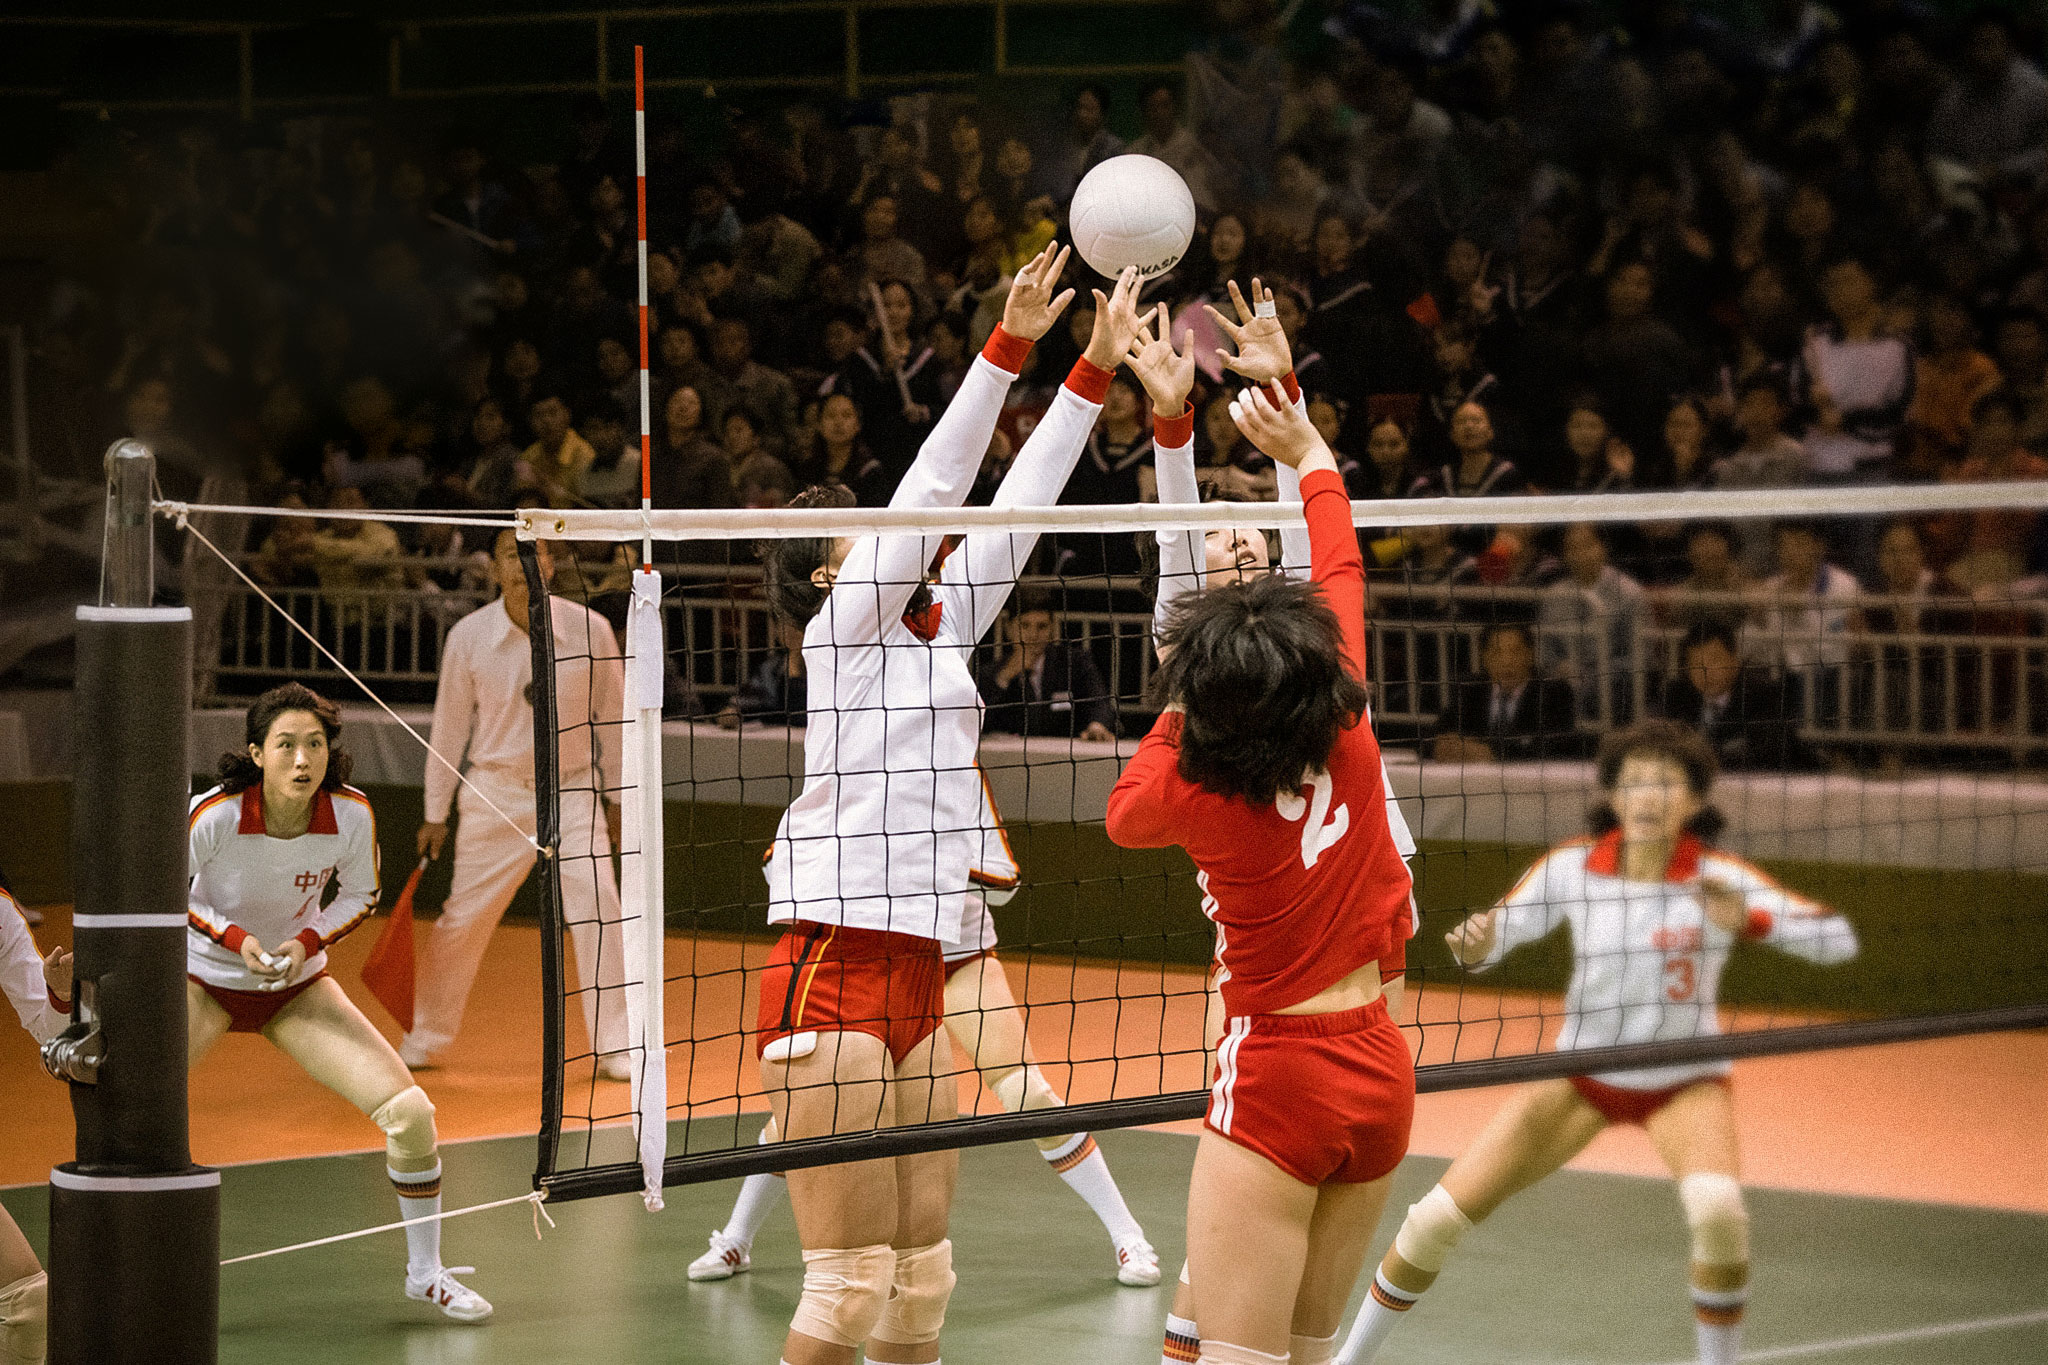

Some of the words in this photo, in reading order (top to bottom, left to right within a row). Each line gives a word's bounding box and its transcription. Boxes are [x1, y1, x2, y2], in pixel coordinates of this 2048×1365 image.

[1116, 255, 1179, 276] IKASA
[1275, 762, 1350, 870] 2
[1666, 959, 1695, 1002] 3
